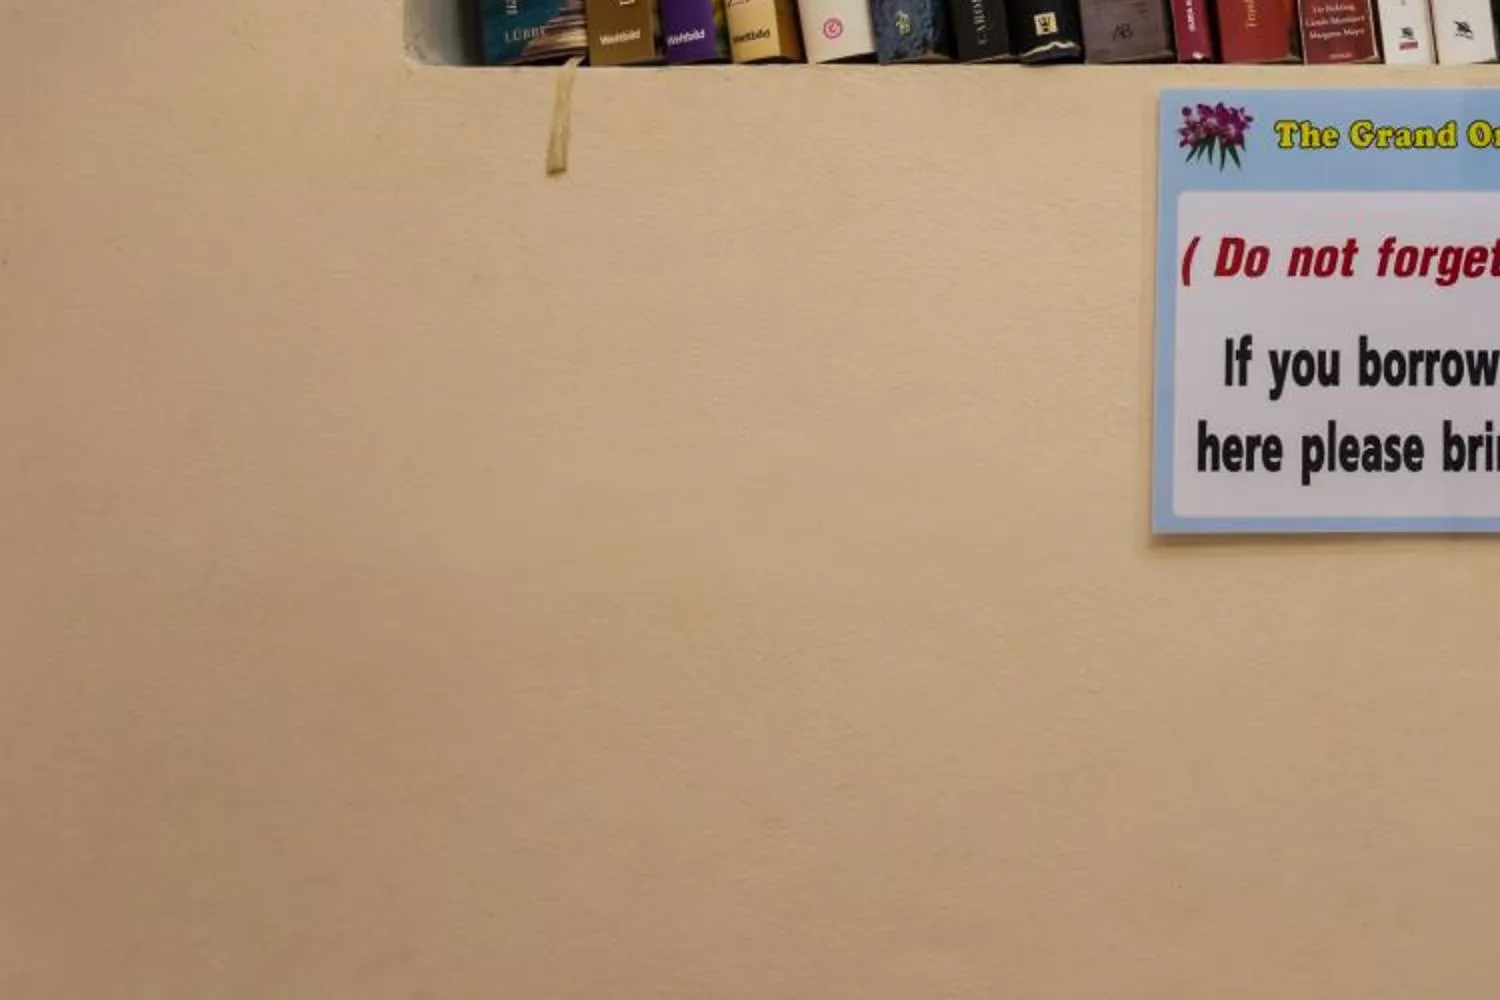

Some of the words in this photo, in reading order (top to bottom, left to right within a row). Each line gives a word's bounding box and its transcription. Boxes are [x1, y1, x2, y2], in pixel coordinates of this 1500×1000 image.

[1274, 120, 1340, 149] The
[1348, 120, 1457, 149] Grand
[1214, 237, 1269, 278] Do
[1287, 237, 1360, 278] not
[1224, 335, 1253, 387] If
[1268, 350, 1341, 401] you
[1359, 335, 1500, 387] borrow
[1197, 420, 1283, 473] here
[1301, 420, 1424, 488] please
